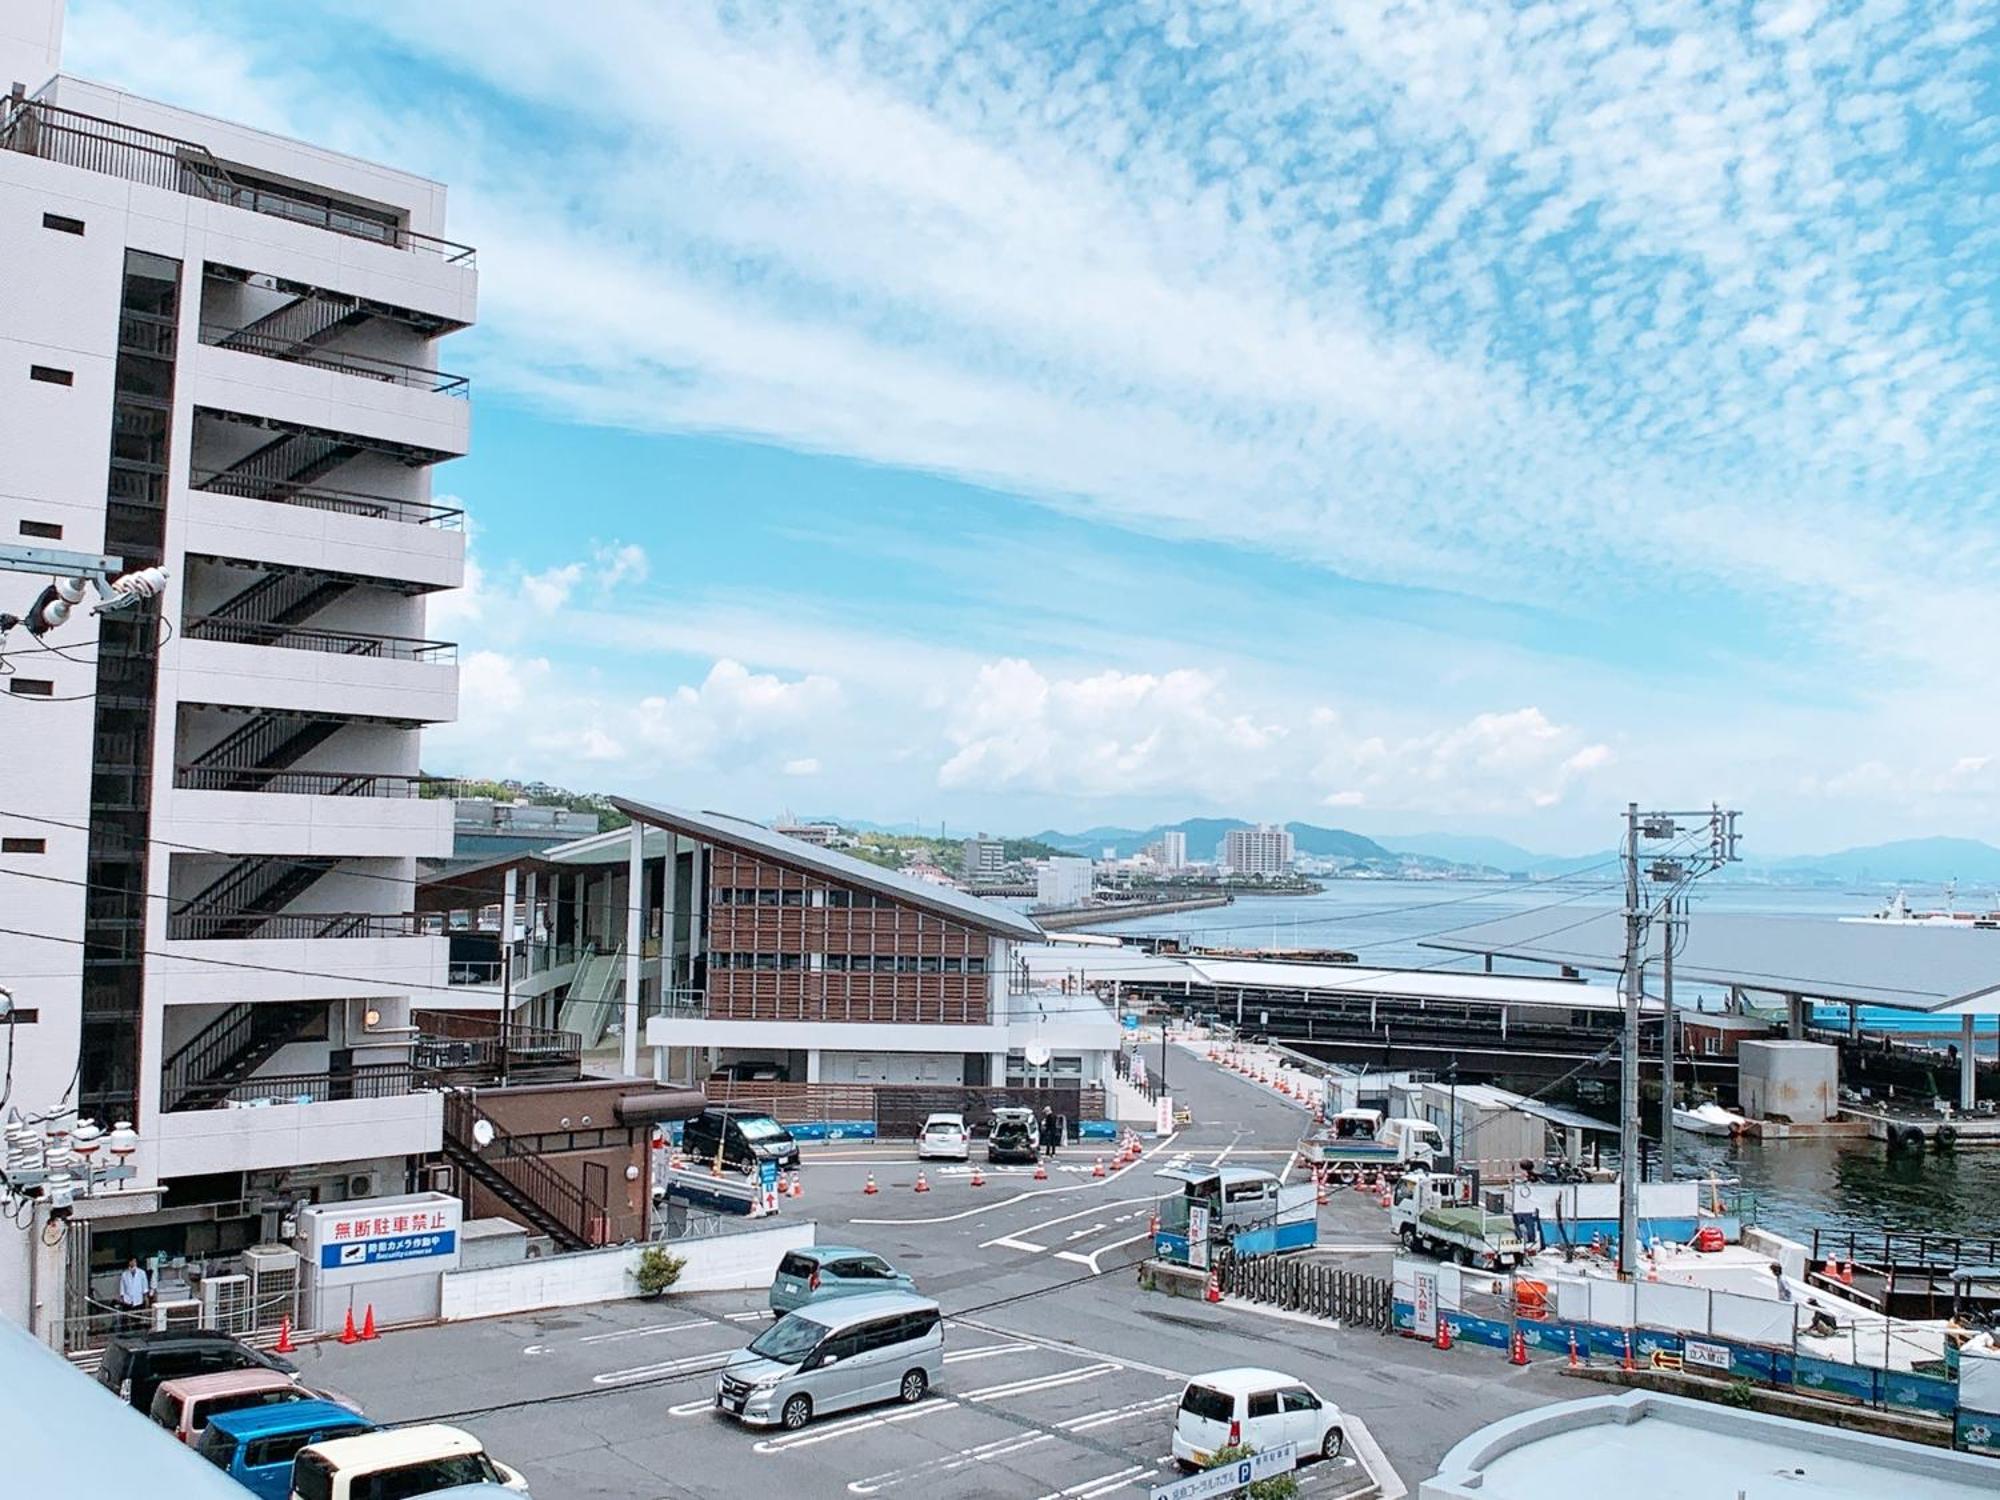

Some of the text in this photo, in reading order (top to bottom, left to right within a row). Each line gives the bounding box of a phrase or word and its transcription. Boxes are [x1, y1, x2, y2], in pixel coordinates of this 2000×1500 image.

[335, 1211, 446, 1239] 無断駐車禁止
